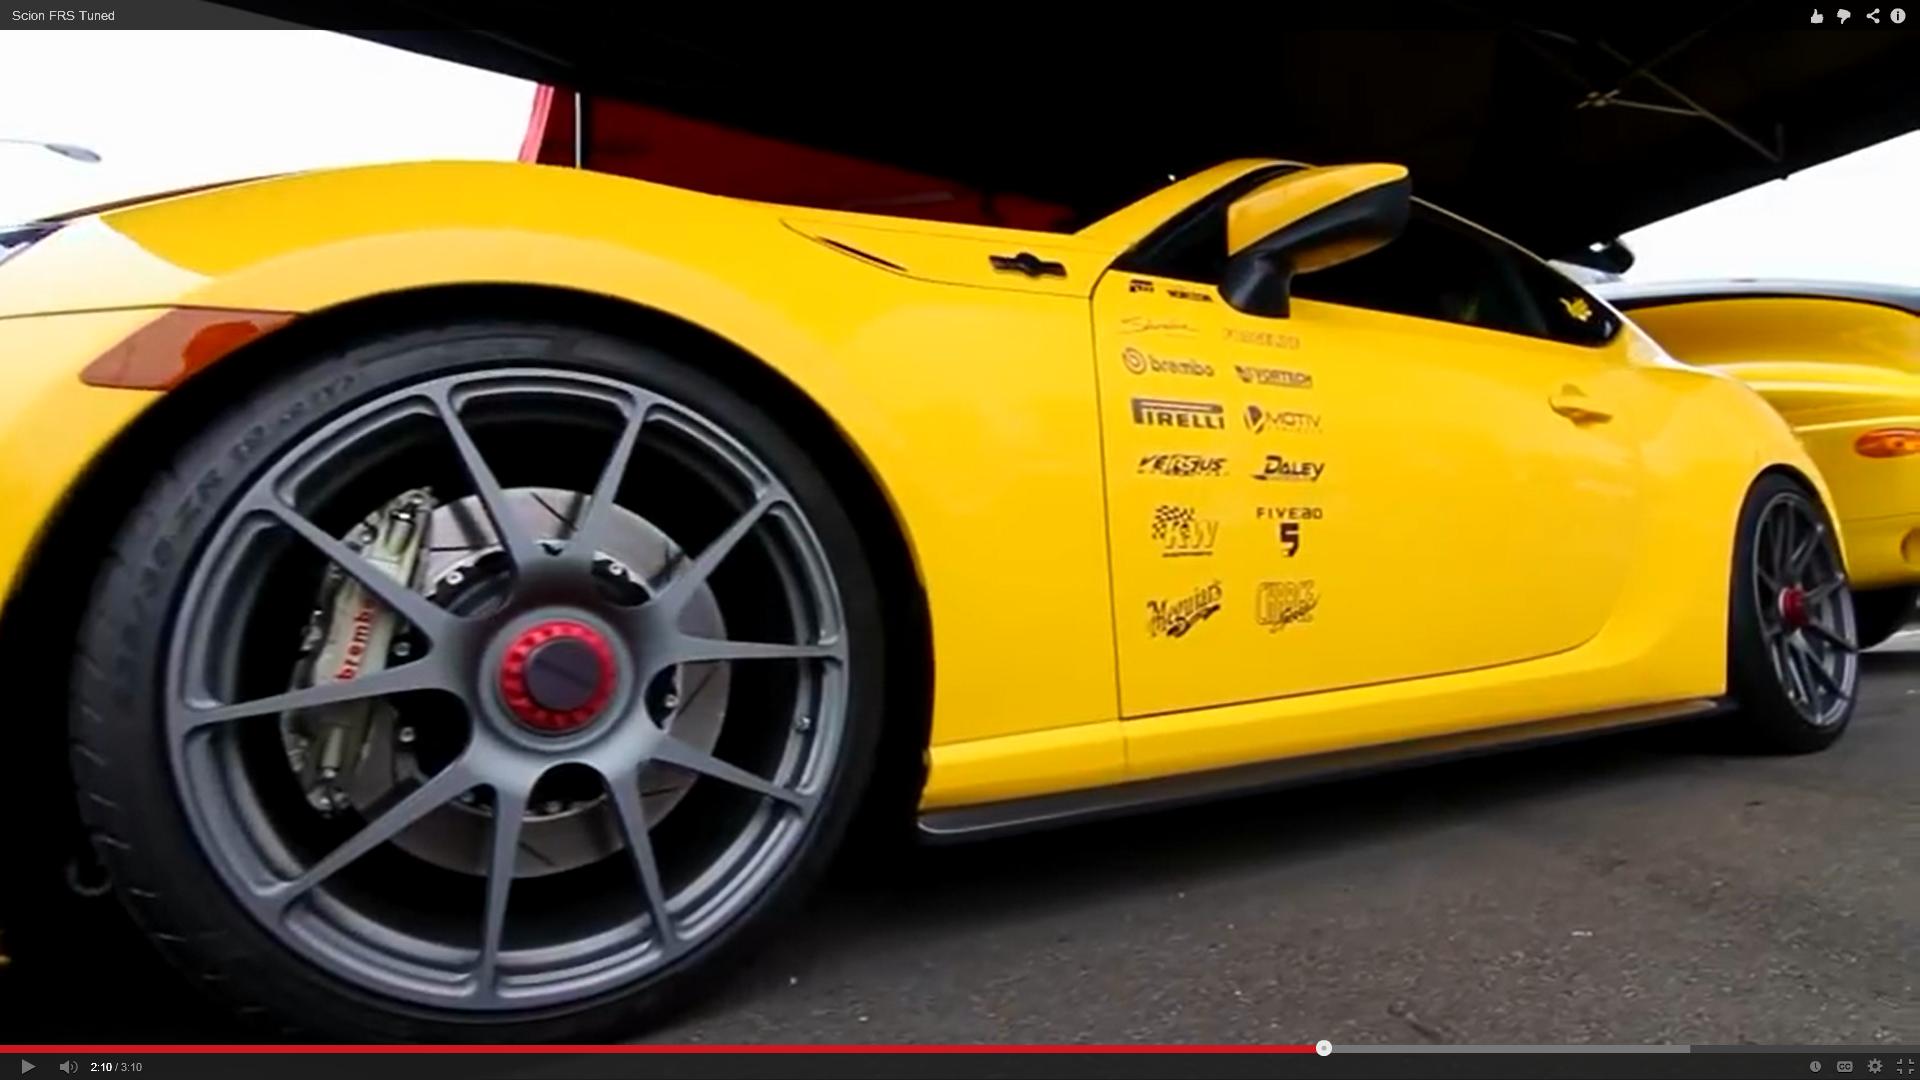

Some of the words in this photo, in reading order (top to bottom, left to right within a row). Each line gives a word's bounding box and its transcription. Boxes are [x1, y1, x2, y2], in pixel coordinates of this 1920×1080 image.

[1150, 354, 1215, 378] brembo
[1131, 397, 1226, 430] PIRELLI
[1265, 410, 1322, 429] MOTIV
[333, 605, 375, 680] bremb
